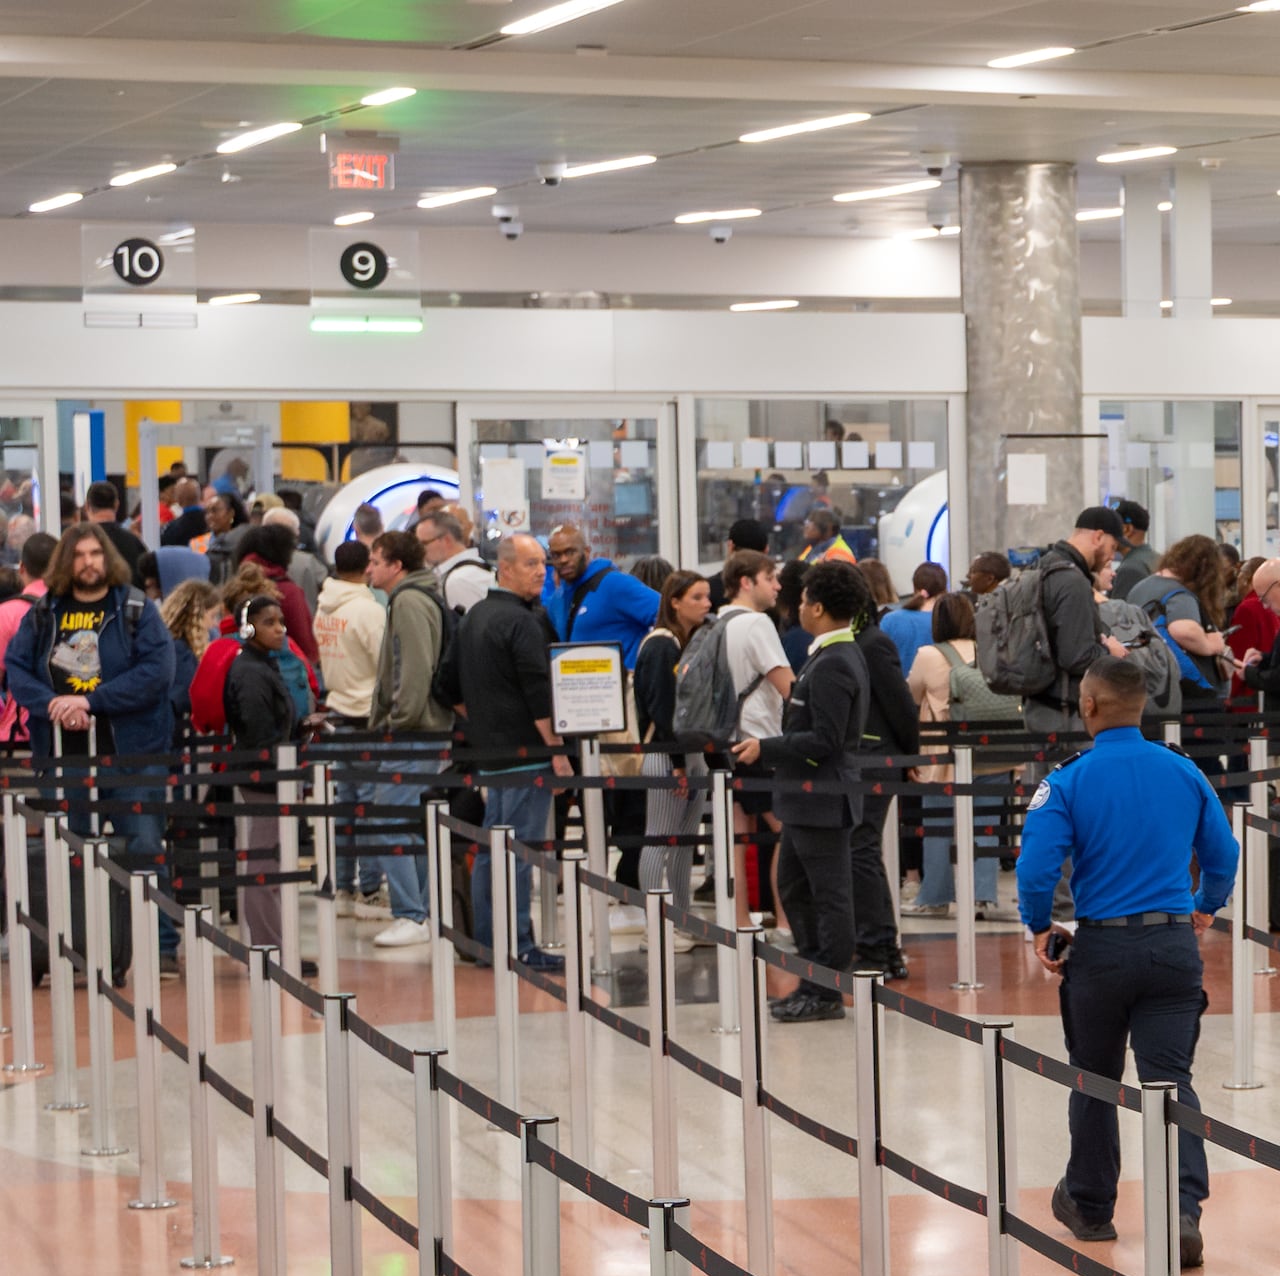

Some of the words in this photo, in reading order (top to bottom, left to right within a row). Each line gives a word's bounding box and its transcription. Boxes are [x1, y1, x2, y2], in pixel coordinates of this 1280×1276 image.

[337, 153, 388, 188] EXIT
[117, 246, 160, 278] 10
[352, 250, 376, 281] 9
